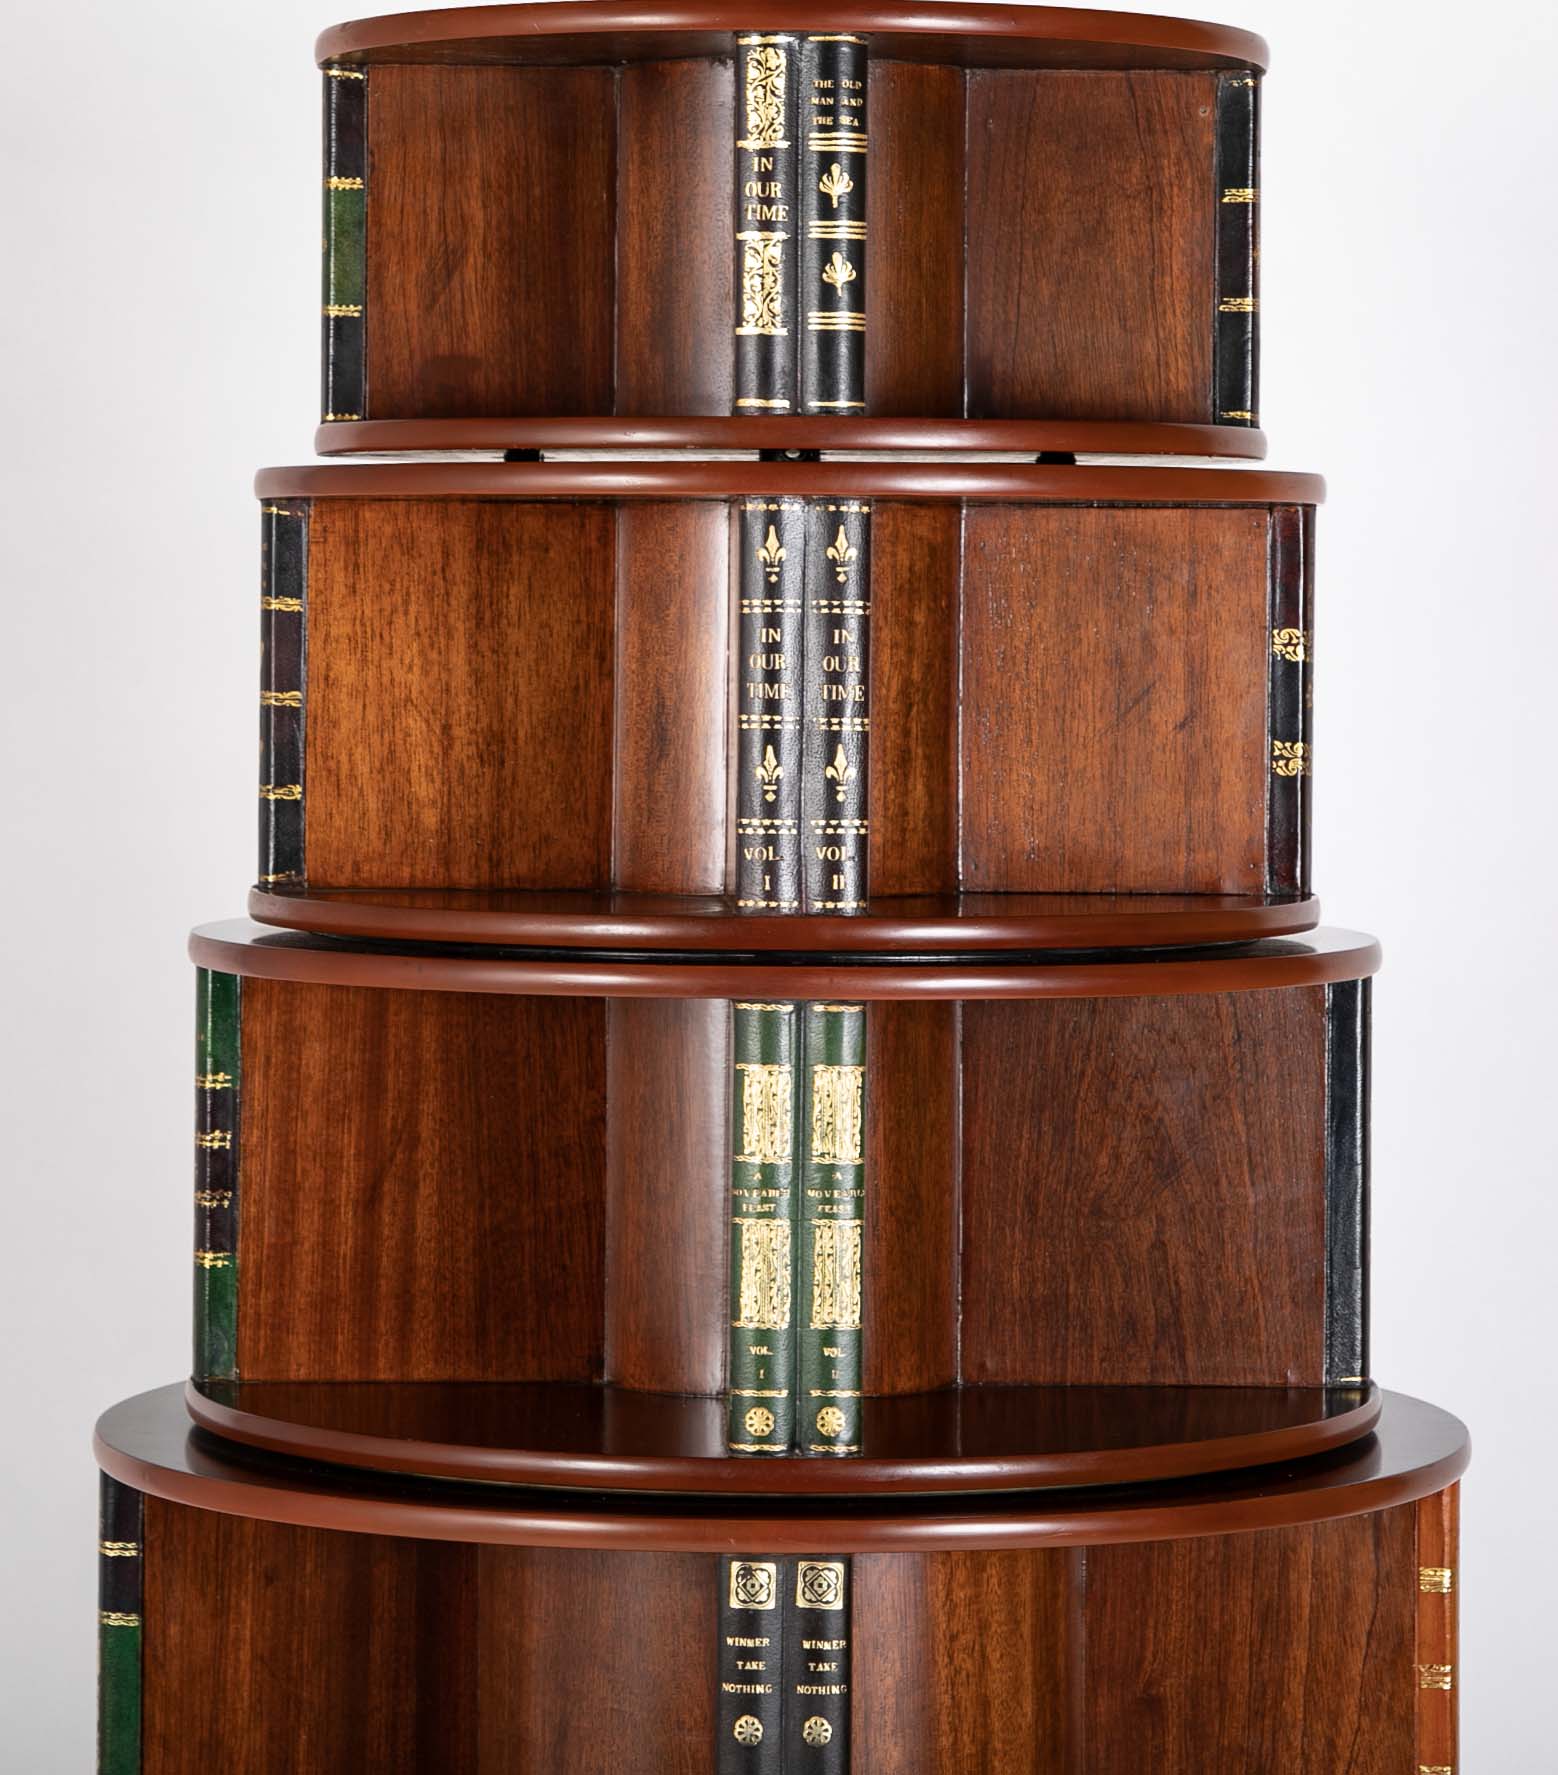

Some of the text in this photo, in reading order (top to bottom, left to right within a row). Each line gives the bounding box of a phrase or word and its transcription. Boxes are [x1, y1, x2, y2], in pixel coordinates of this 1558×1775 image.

[813, 79, 862, 89] THE OLD
[811, 96, 863, 107] MAN AND
[813, 115, 859, 126] THE SEA
[753, 157, 773, 172] IN
[745, 182, 782, 198] OUR
[745, 205, 789, 222] TIME
[761, 628, 781, 643] IN
[833, 629, 854, 644] IN
[750, 653, 786, 670] OUR
[823, 656, 860, 673] OUR
[746, 683, 790, 700] TIME
[821, 685, 865, 702] TIME
[763, 875, 771, 891] I
[832, 874, 846, 890] II
[753, 1172, 762, 1180] A
[832, 1172, 843, 1181] A
[742, 1203, 777, 1213] FEAST
[759, 1369, 765, 1380] I
[726, 1636, 771, 1648] WINNER
[802, 1639, 848, 1651] WINNER
[736, 1661, 767, 1671] TAKE
[808, 1662, 839, 1673] TAKE
[722, 1681, 773, 1694] NOTHING
[796, 1684, 848, 1696] NOTHING
